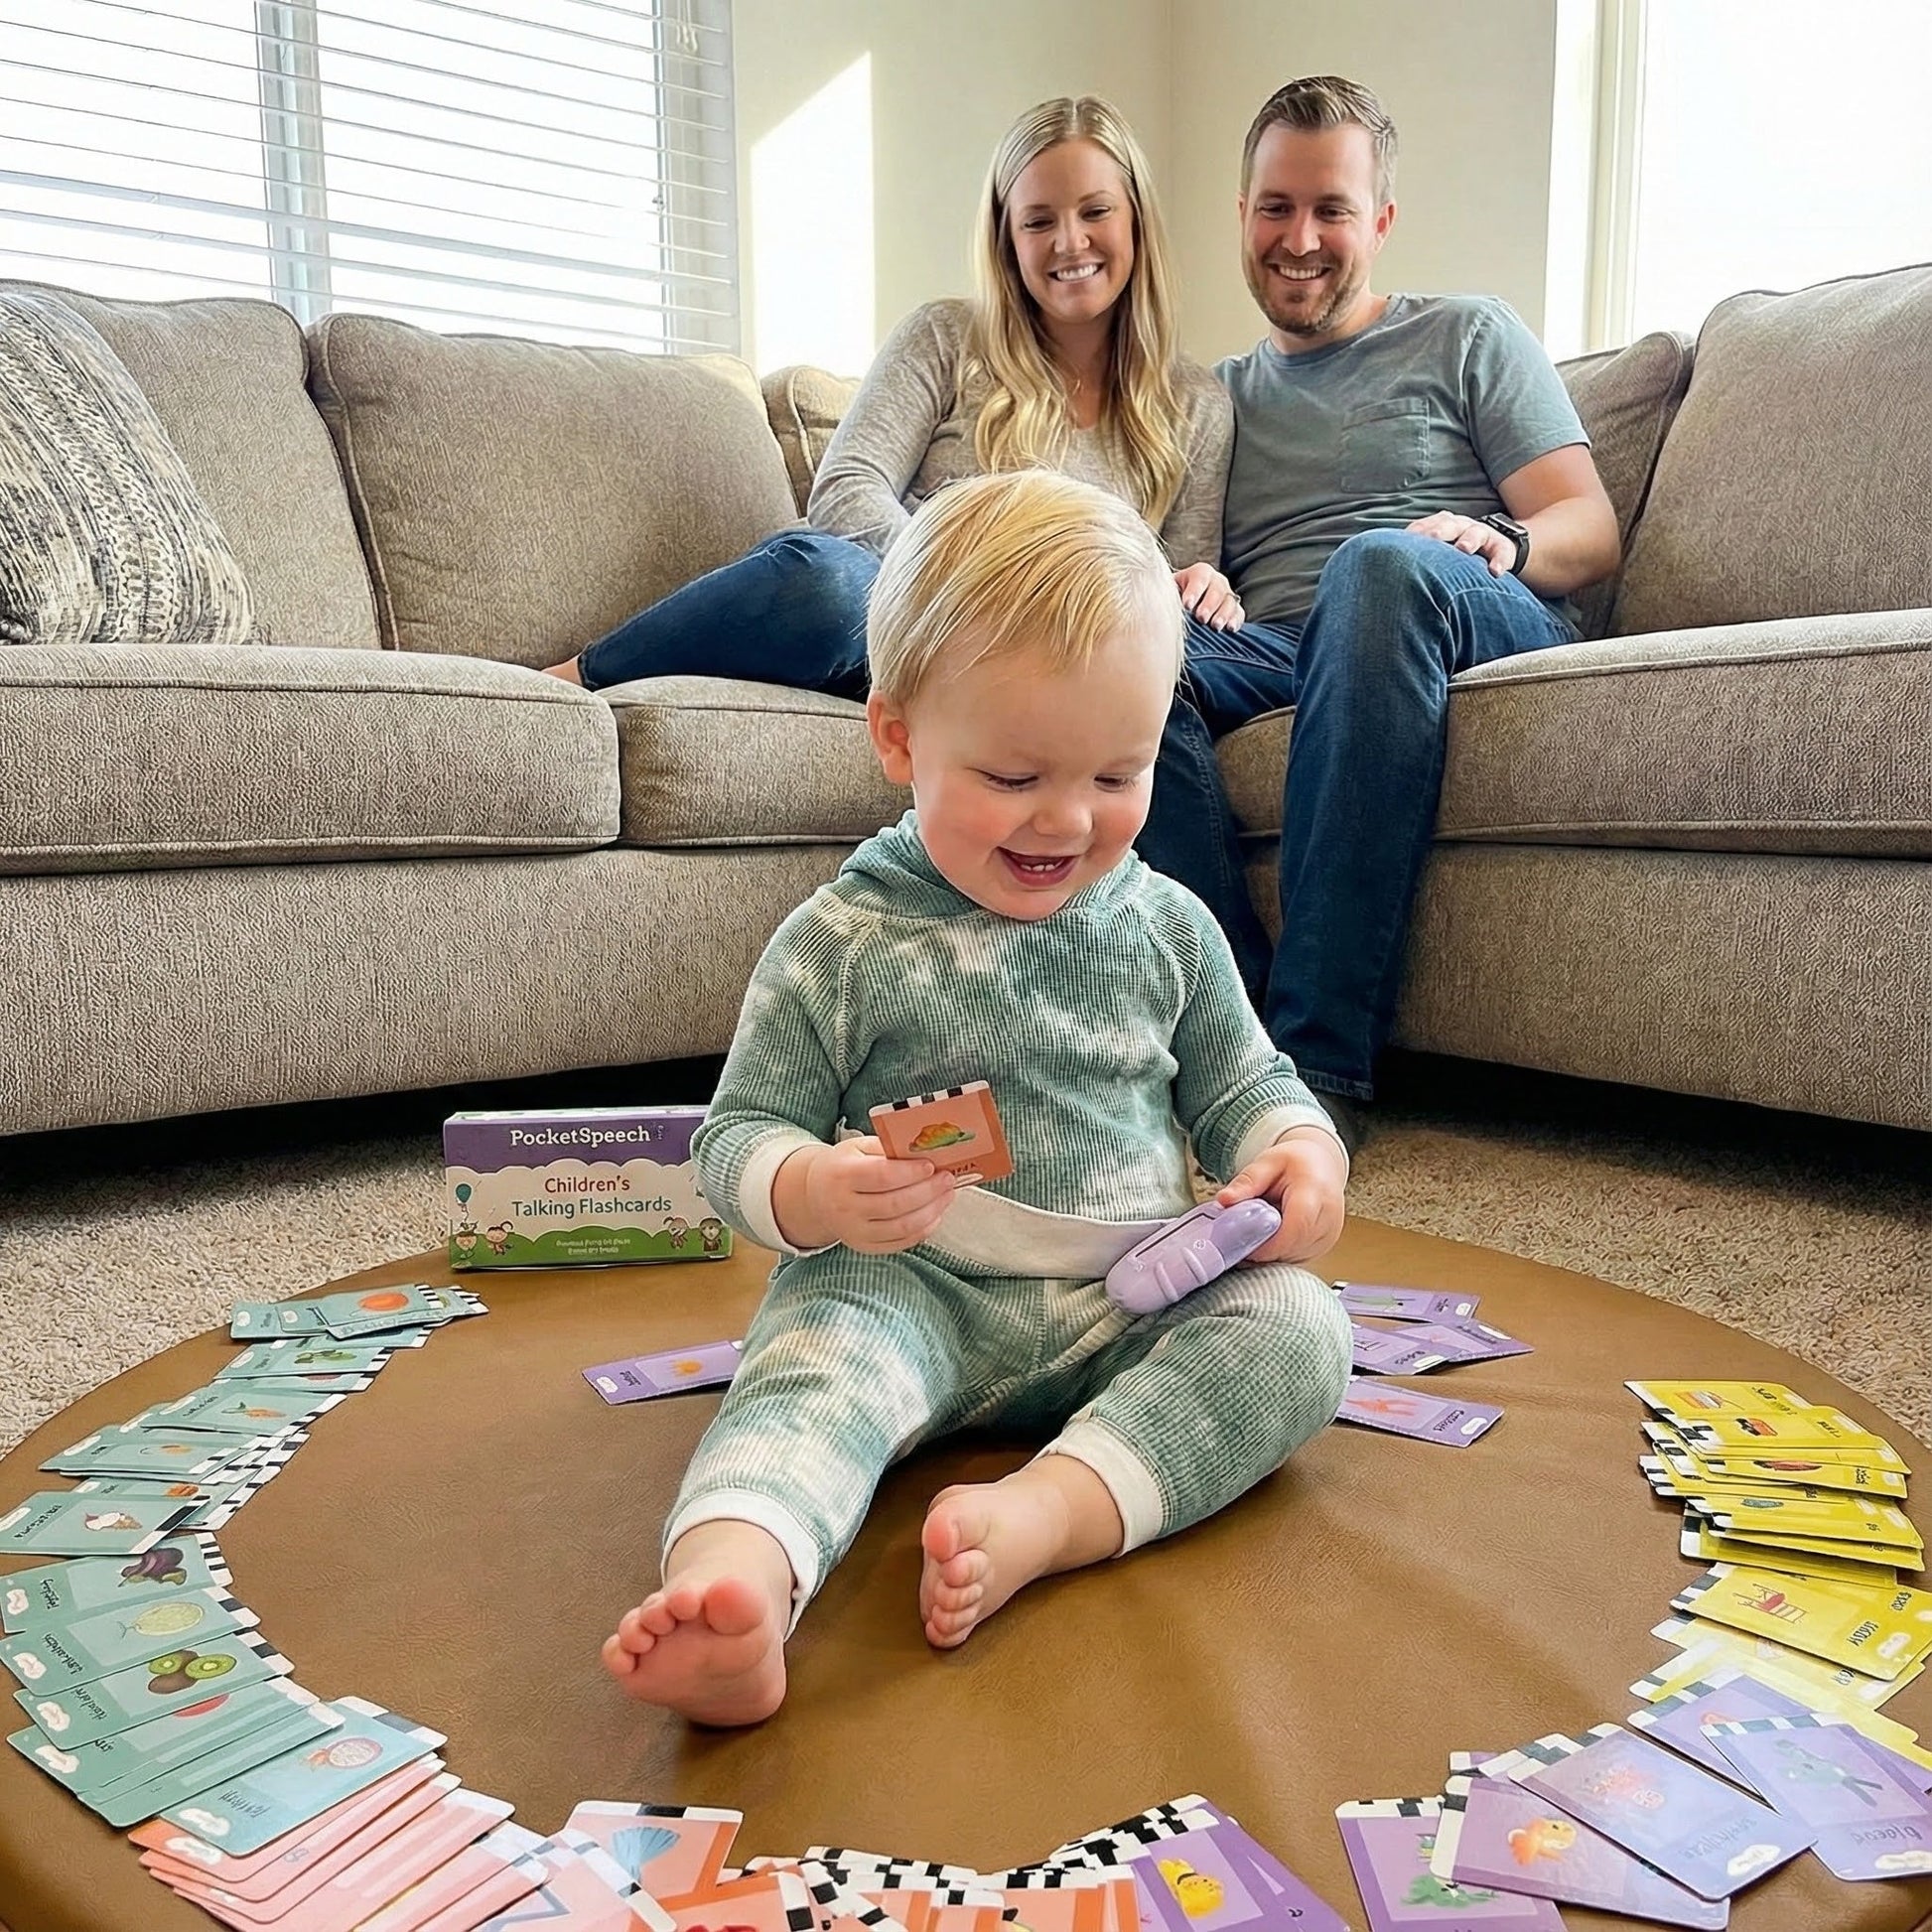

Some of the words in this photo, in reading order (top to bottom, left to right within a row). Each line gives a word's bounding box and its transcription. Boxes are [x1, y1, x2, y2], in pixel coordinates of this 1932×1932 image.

[509, 1124, 651, 1149] PocketSpeech
[544, 1174, 630, 1193] Children's
[511, 1199, 575, 1219] Talking
[579, 1196, 672, 1214] Flashcards
